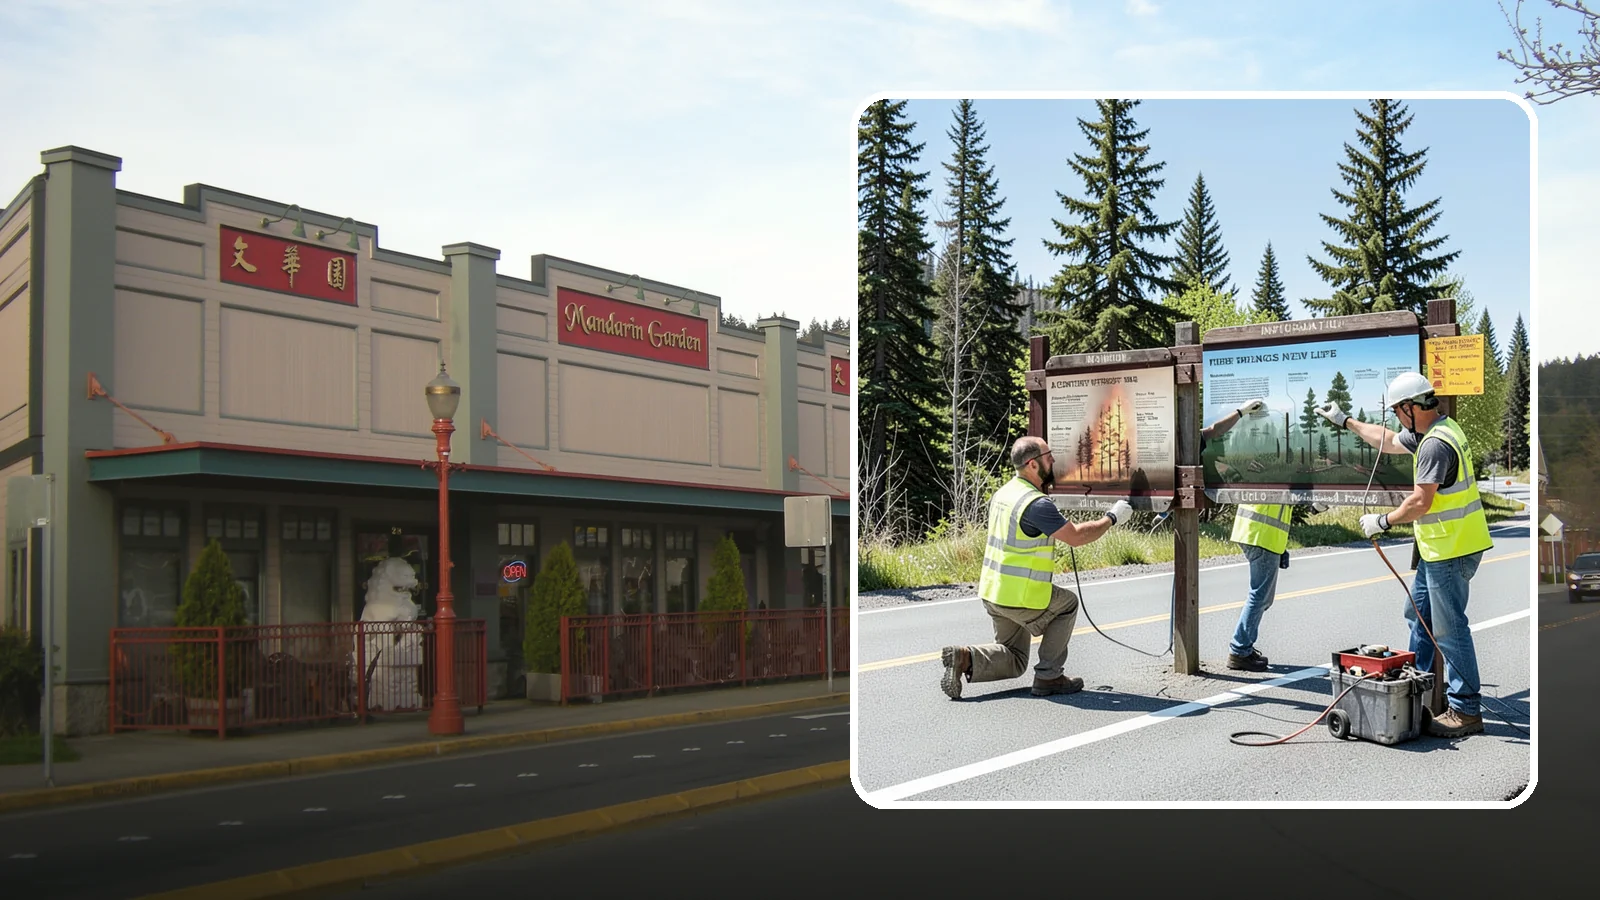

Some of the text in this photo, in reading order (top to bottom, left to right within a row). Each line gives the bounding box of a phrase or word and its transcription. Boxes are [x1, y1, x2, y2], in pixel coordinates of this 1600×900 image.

[230, 235, 346, 291] 文華園
[564, 302, 702, 352] Mandarin Garden
[503, 565, 527, 578] OPEN
